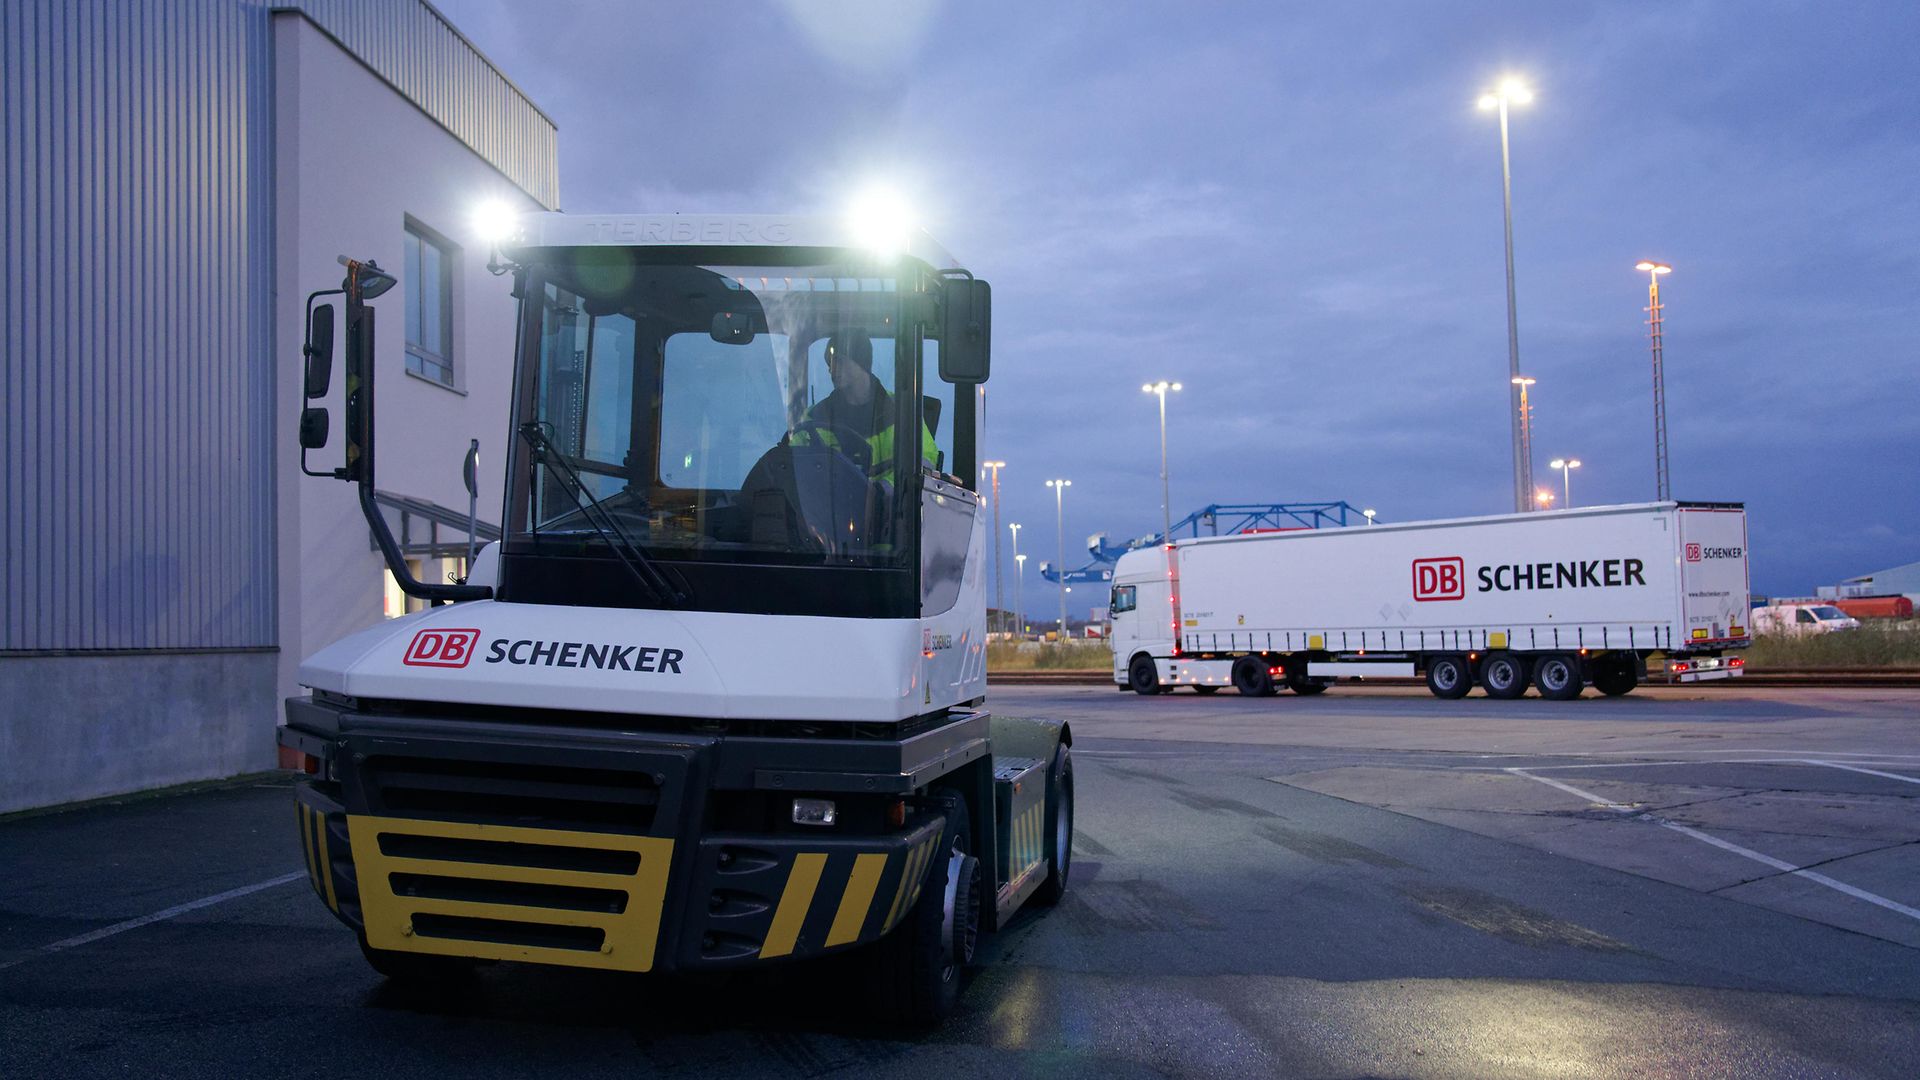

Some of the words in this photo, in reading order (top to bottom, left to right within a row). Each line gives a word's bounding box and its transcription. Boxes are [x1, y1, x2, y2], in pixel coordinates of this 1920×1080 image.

[586, 222, 792, 243] TERBERG
[1687, 546, 1700, 559] DB
[1703, 547, 1743, 559] SCHENKER
[1419, 564, 1459, 595] DB
[1477, 558, 1647, 593] SCHENKER
[413, 633, 469, 661] DB
[485, 638, 684, 674] SCHENKER
